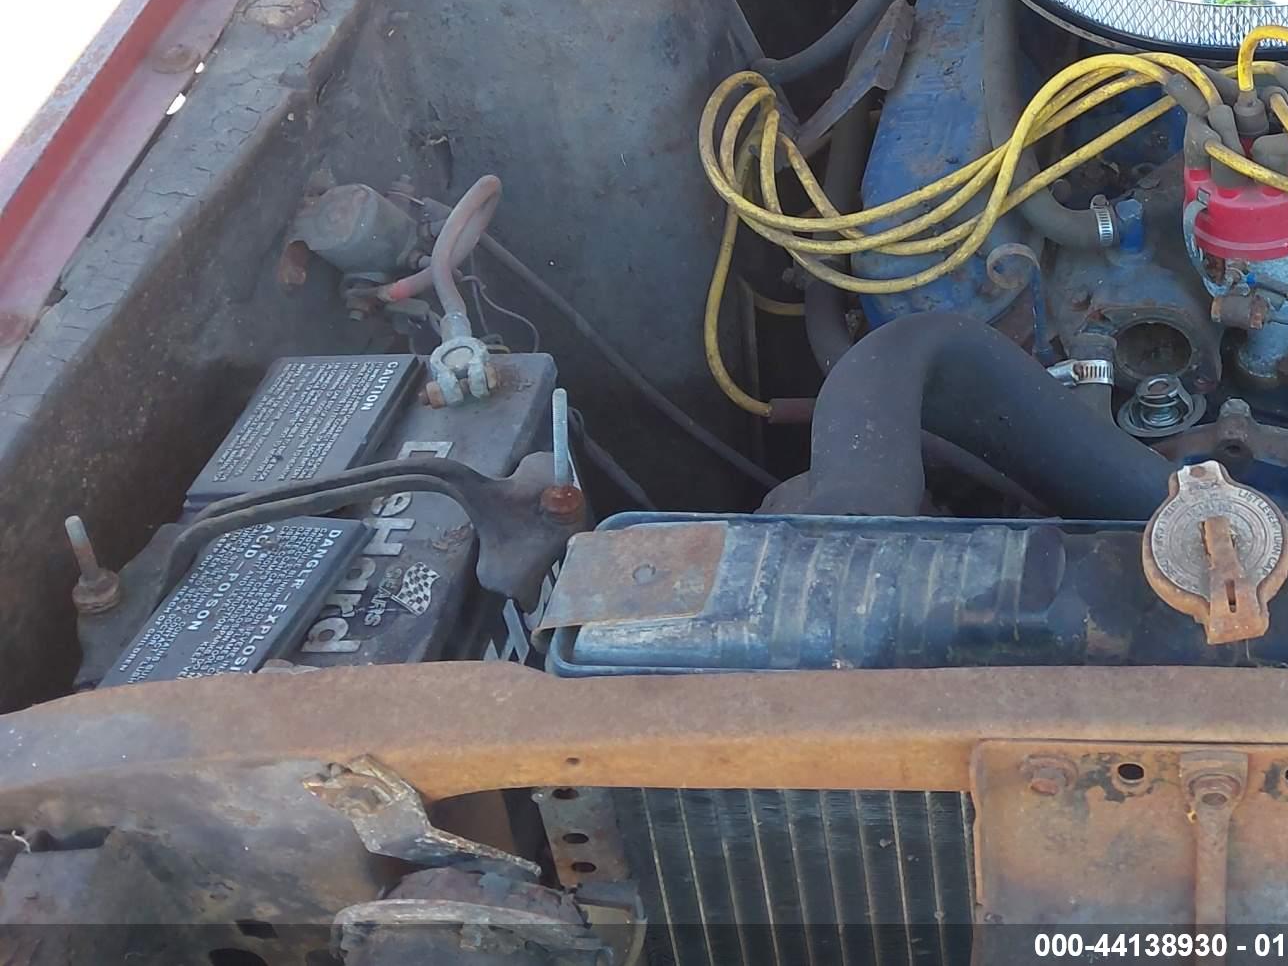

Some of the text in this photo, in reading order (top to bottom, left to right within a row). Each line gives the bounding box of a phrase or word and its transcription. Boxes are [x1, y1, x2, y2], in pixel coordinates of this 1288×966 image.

[359, 362, 400, 410] CAUTION
[243, 525, 276, 557] ACID
[301, 441, 454, 653] DeHard
[187, 572, 238, 629] POISON
[364, 562, 403, 627] SEARS
[233, 604, 287, 670] EXPLOSI
